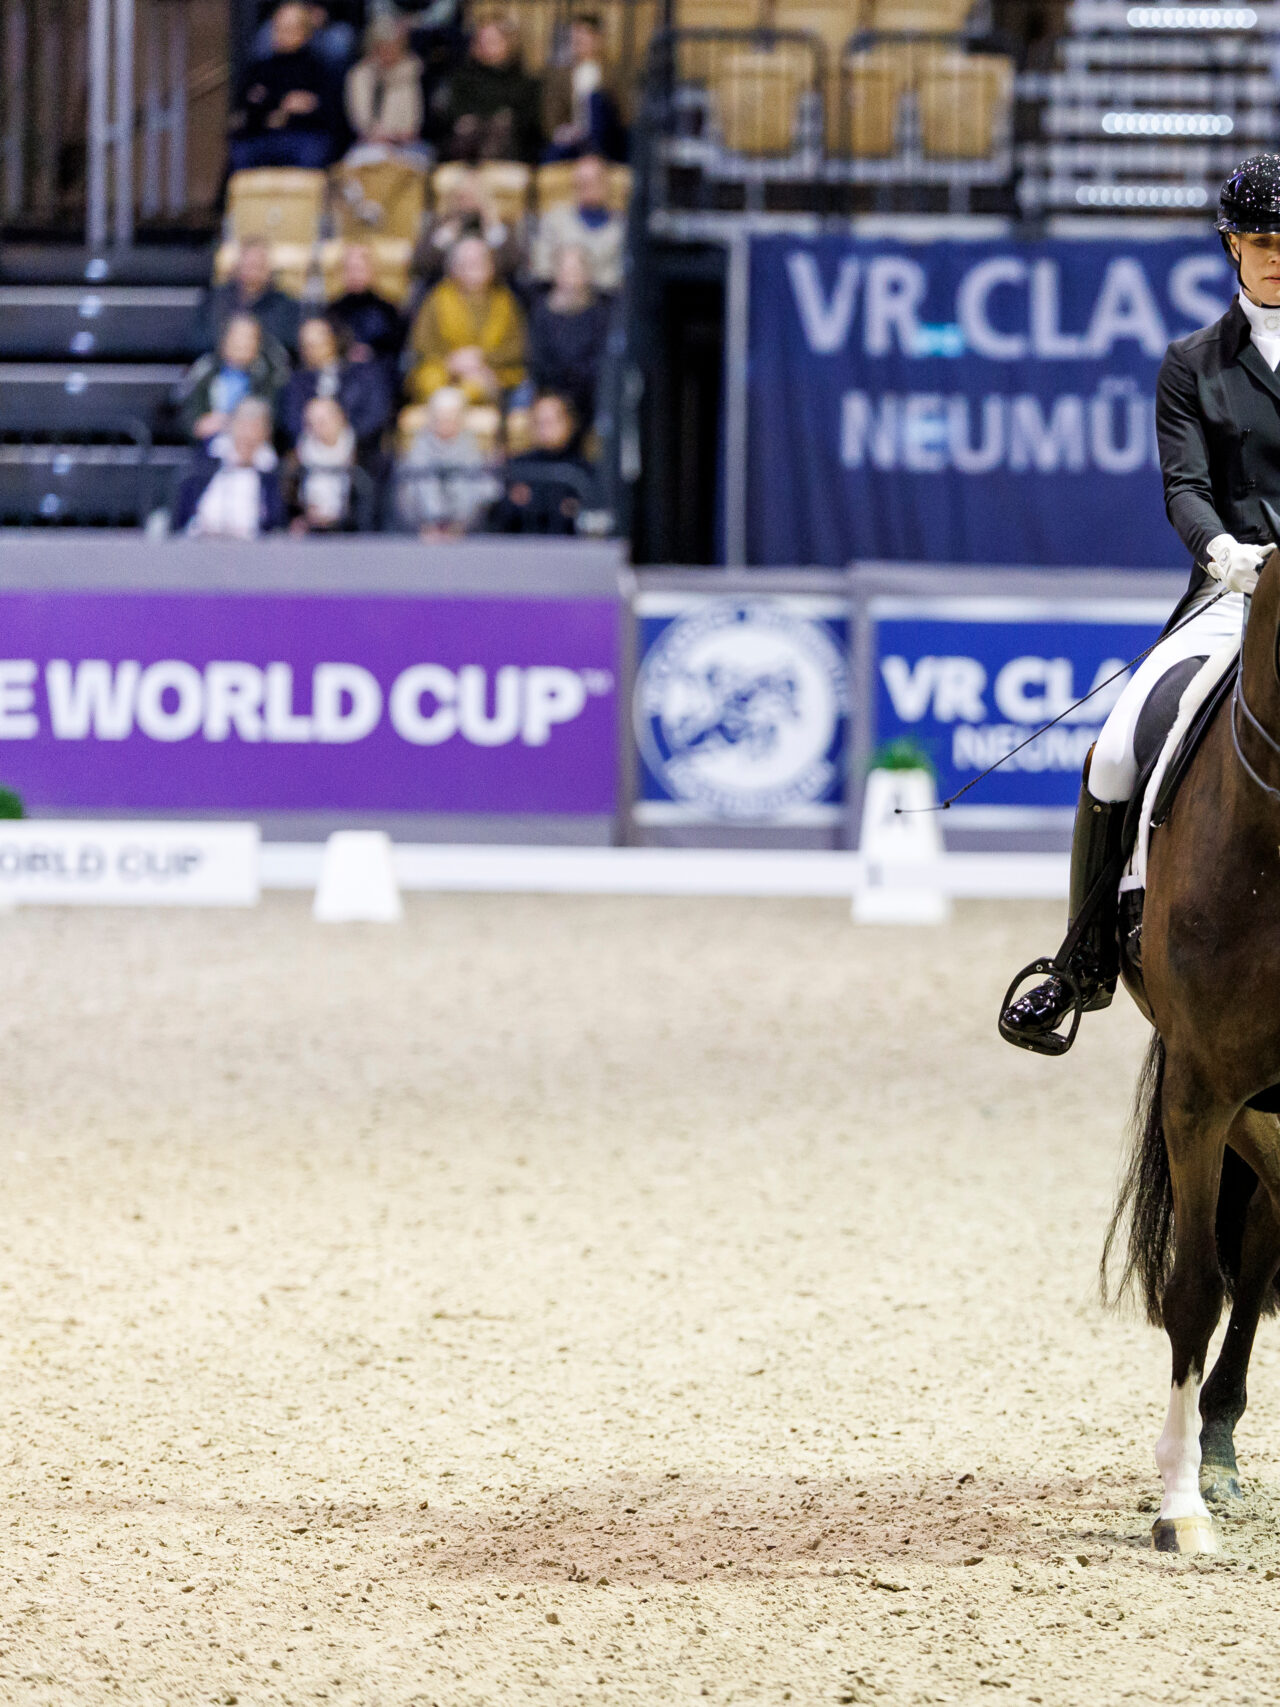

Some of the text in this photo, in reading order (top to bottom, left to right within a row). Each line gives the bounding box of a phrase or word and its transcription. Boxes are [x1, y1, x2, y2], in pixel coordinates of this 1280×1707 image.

[787, 250, 928, 358] VR
[45, 657, 383, 745] WORLD
[880, 655, 987, 723] VR
